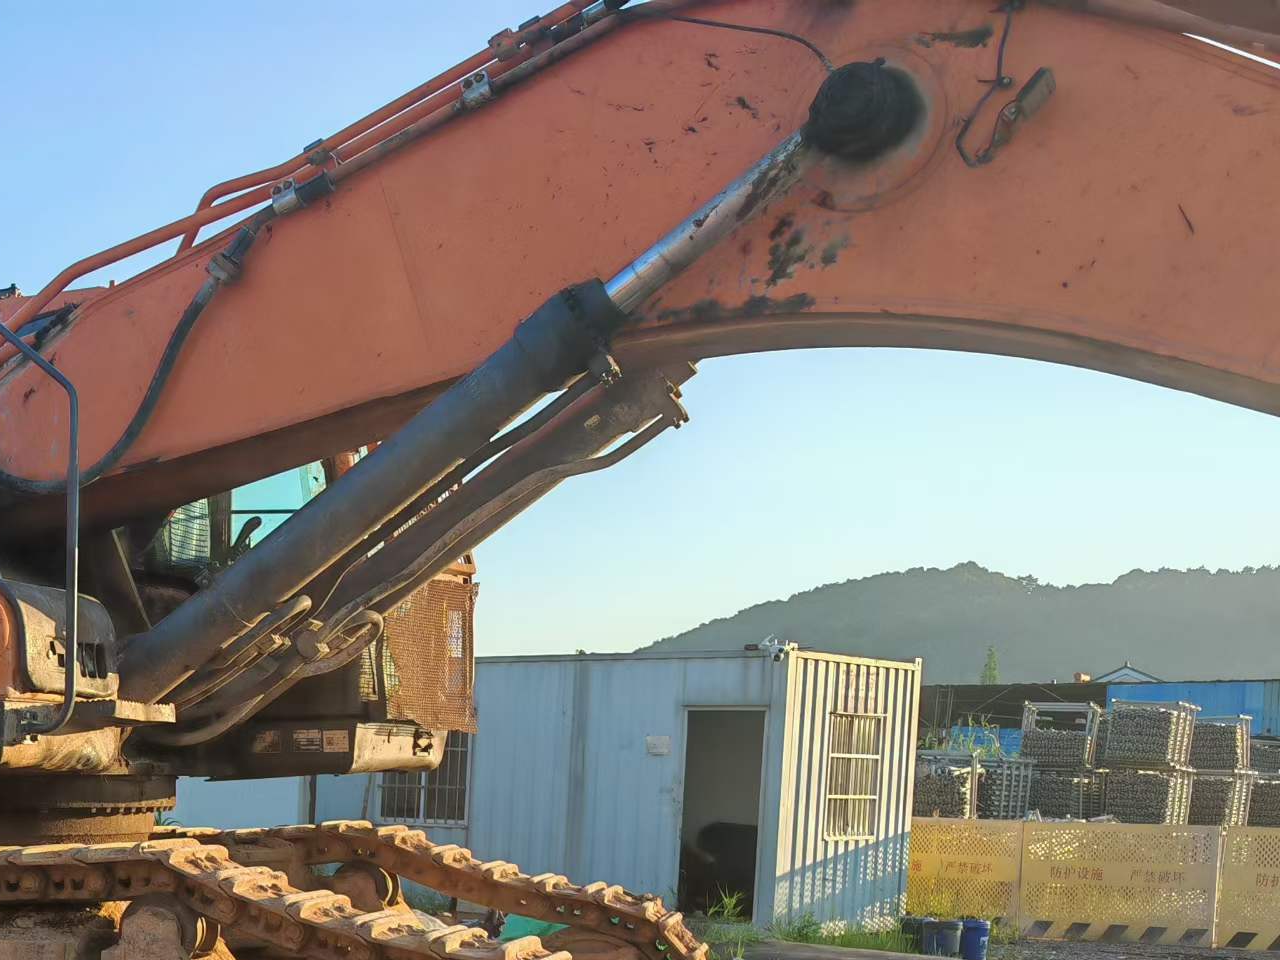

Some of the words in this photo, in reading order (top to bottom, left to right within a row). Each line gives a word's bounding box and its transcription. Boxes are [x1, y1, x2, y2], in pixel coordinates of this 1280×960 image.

[1049, 865, 1104, 881] 防护设施
[1129, 869, 1186, 885] 严禁破坏
